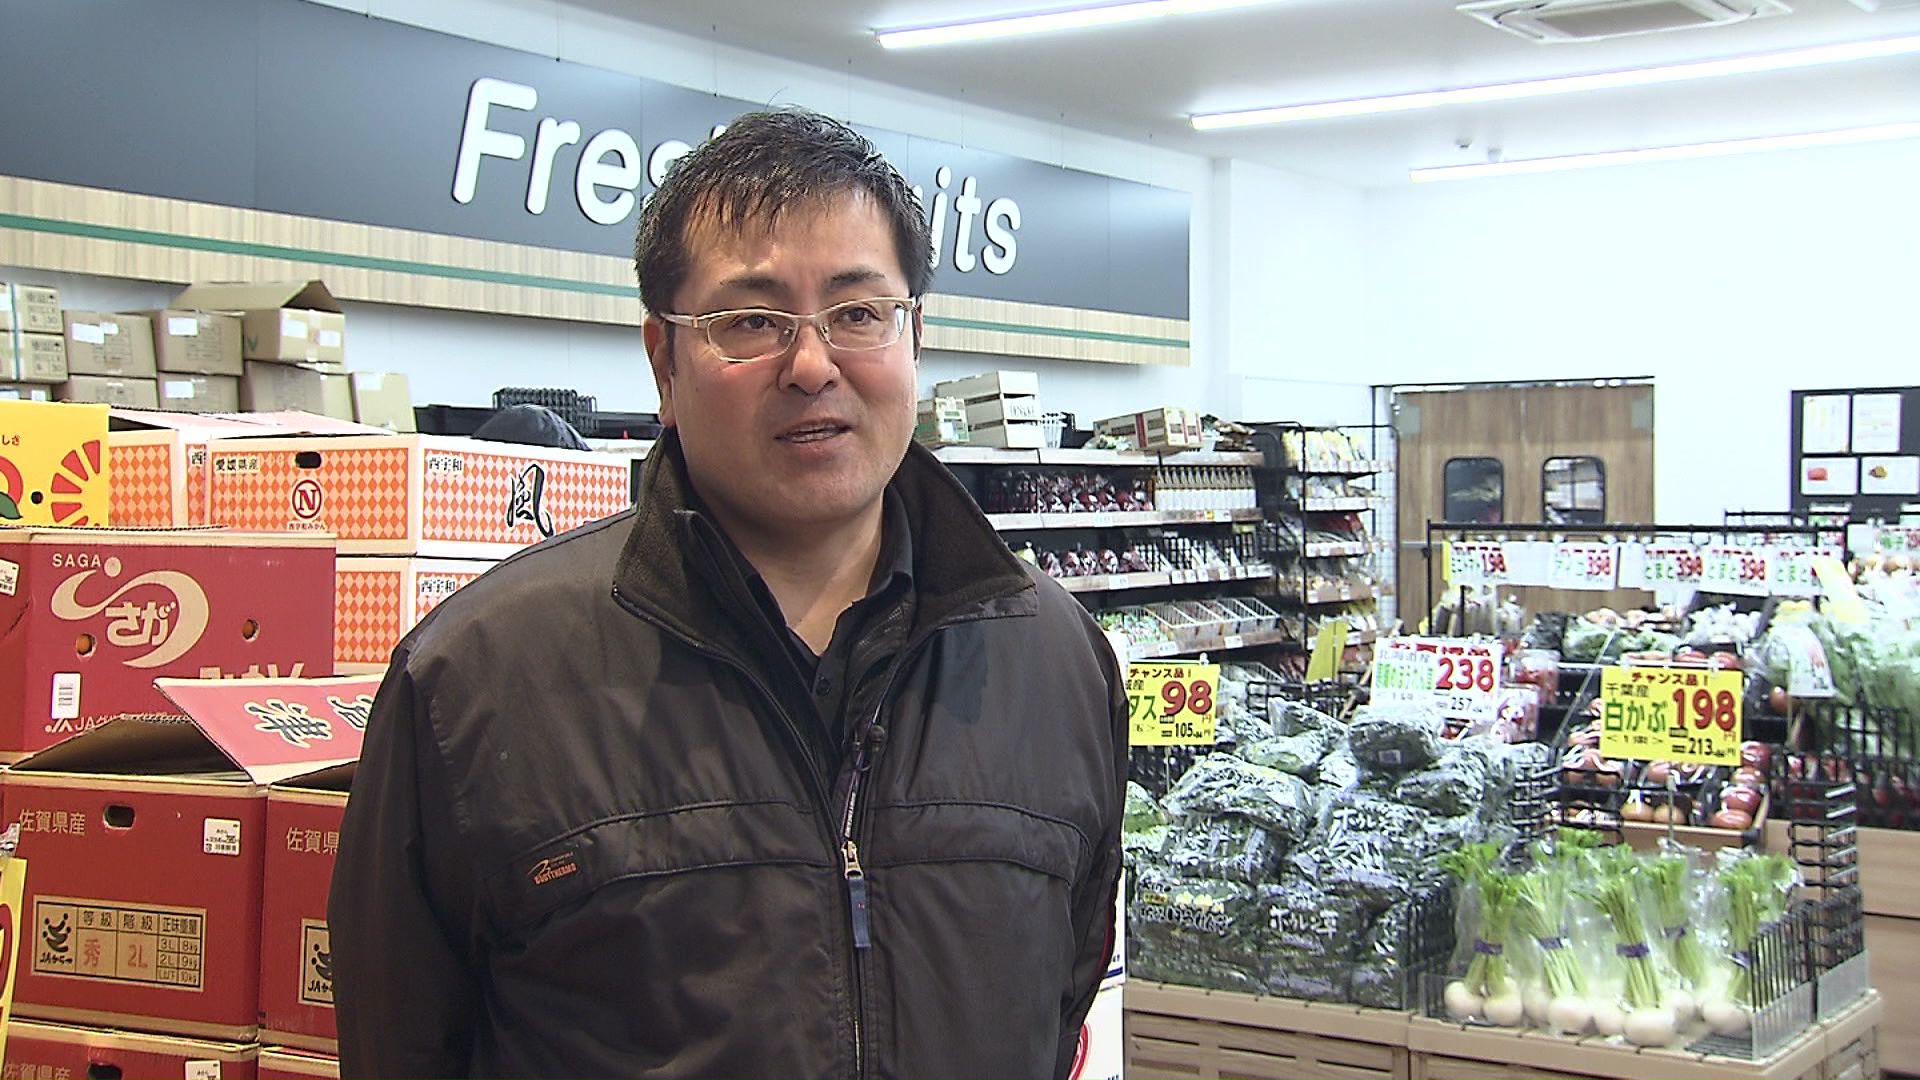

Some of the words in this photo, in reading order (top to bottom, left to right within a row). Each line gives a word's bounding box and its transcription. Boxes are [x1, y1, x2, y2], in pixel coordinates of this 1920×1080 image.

[452, 77, 728, 225] Fres
[912, 165, 1021, 275] its
[191, 452, 206, 465] 西
[215, 457, 258, 472] 愛媛県産
[52, 553, 101, 568] SAGA
[105, 602, 176, 647] さが
[1436, 657, 1494, 692] 238
[1160, 680, 1213, 716] 98
[1672, 687, 1736, 731] 198
[1604, 697, 1668, 733] 白かぶ
[20, 808, 86, 836] 佐賀県産
[83, 911, 113, 928] 等級
[123, 914, 154, 931] 階級
[162, 917, 198, 935] 正味重量
[84, 938, 101, 968] 秀
[127, 944, 148, 969] 2L
[161, 938, 175, 950] 3L
[160, 954, 174, 966] 2L
